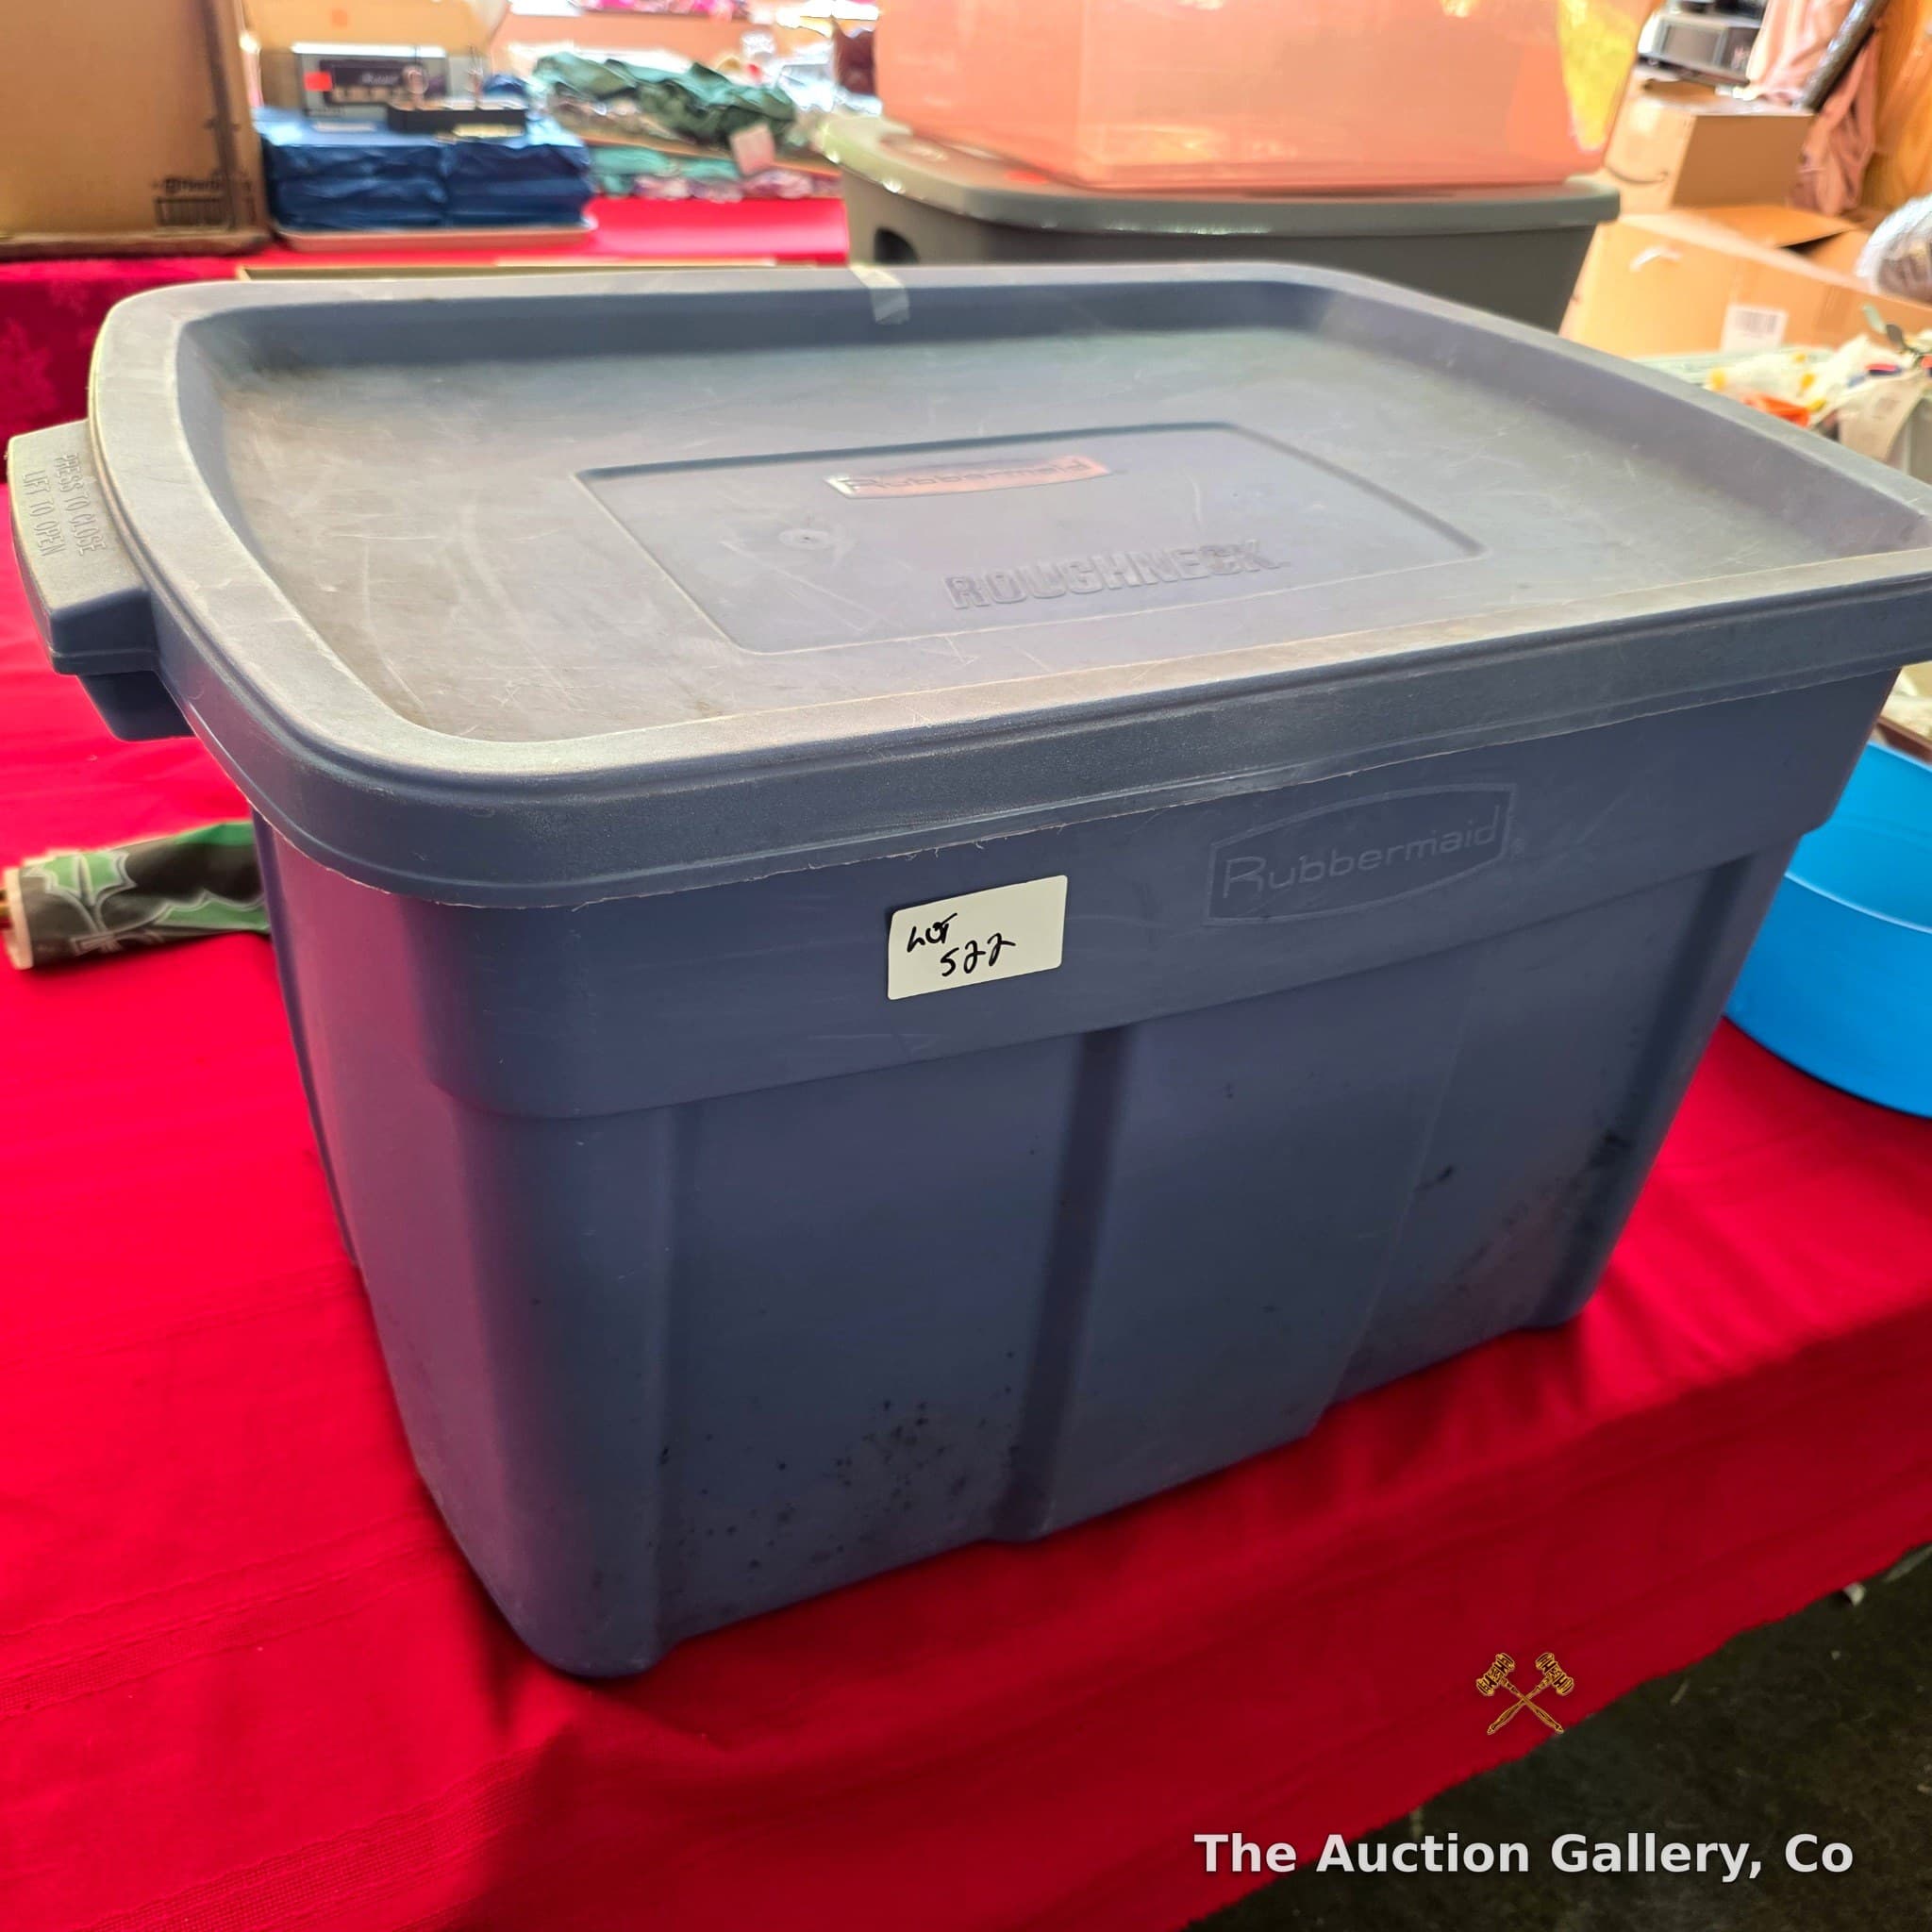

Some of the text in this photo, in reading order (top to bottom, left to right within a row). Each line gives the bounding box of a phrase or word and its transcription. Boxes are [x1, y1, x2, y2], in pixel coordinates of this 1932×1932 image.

[23, 469, 66, 557] LIFT TO OPEN
[54, 452, 107, 557] PRESS TO CLOSE
[944, 540, 1283, 609] ROUGHNECK
[1223, 805, 1502, 898] Rubbermaid
[940, 932, 1016, 976] 522
